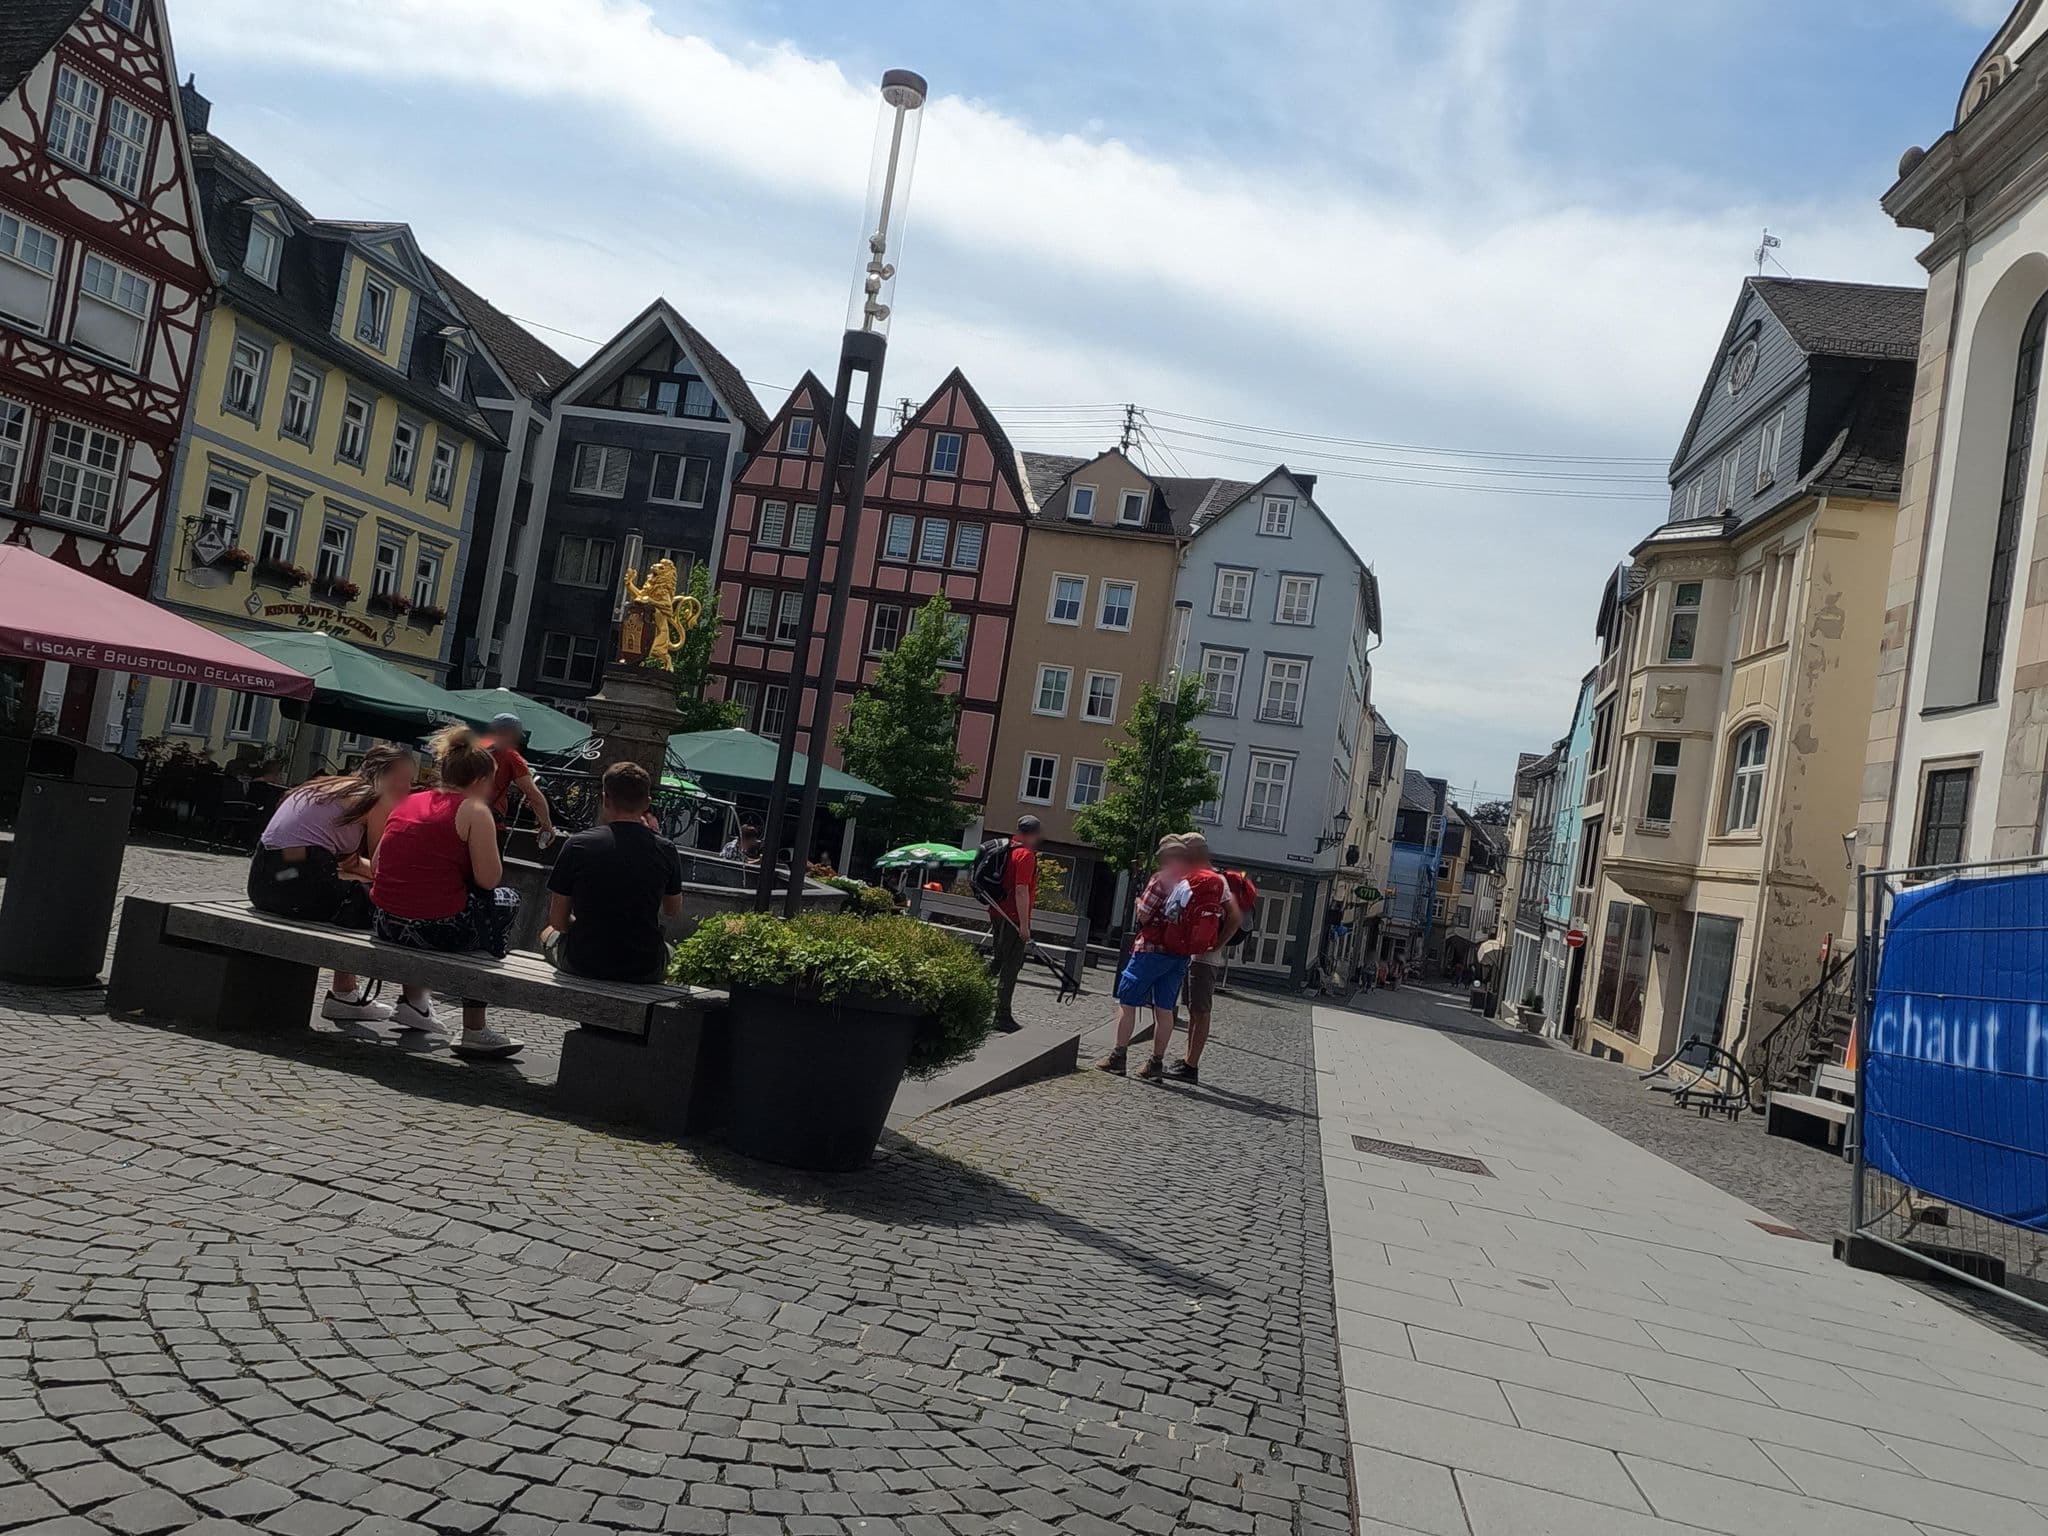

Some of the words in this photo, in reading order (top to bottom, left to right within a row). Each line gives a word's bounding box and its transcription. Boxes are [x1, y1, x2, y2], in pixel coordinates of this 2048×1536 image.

[297, 615, 315, 627] Da
[23, 638, 97, 660] EISCAFÉ
[104, 649, 198, 677] BRUSTOLON
[204, 667, 276, 690] GELATERIA
